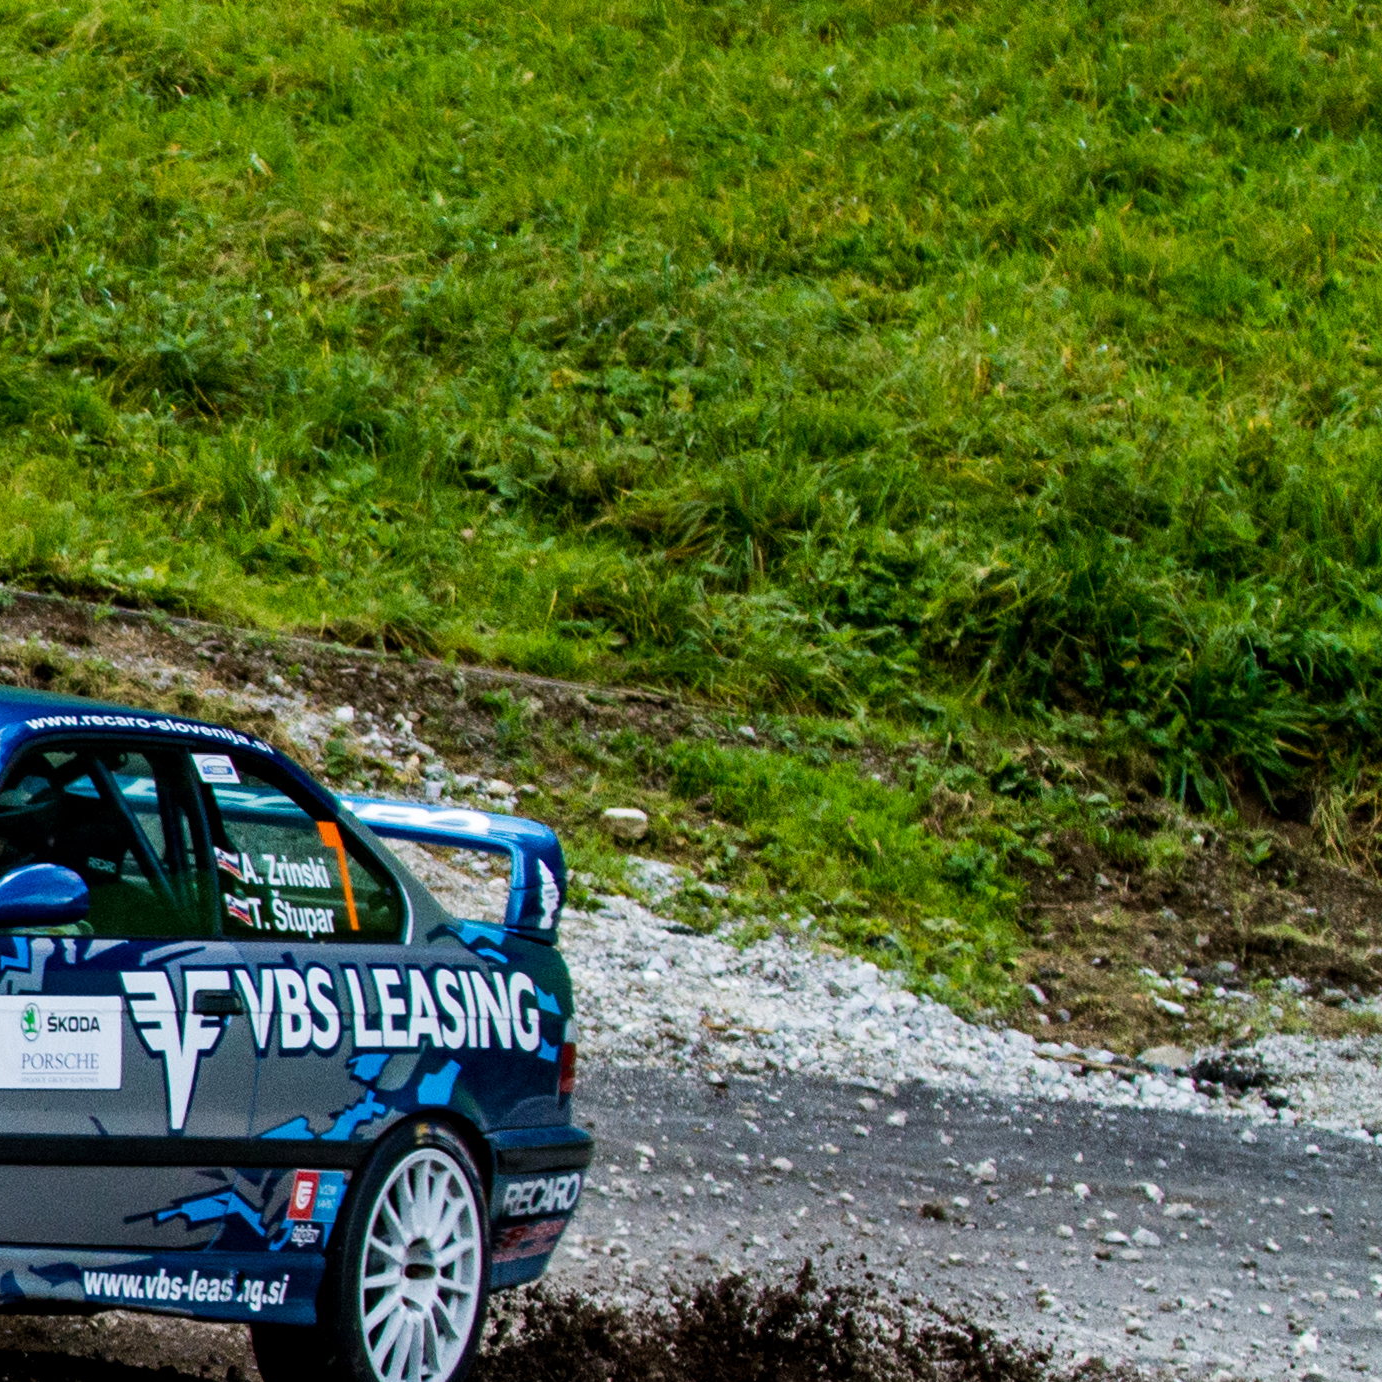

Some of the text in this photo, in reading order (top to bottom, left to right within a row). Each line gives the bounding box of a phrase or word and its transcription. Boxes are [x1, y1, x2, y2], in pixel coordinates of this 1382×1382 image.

[25, 714, 275, 755] www.recaro-slovenija.si
[241, 852, 331, 889] A. Zrinski
[249, 889, 335, 938] T. Štupar
[47, 1012, 101, 1033] ŠKODA
[235, 967, 540, 1051] VBS LEASING
[21, 1053, 100, 1070] PORSCHE
[503, 1173, 582, 1217] RECARO
[84, 1269, 289, 1312] www.vbs-leasng.si
